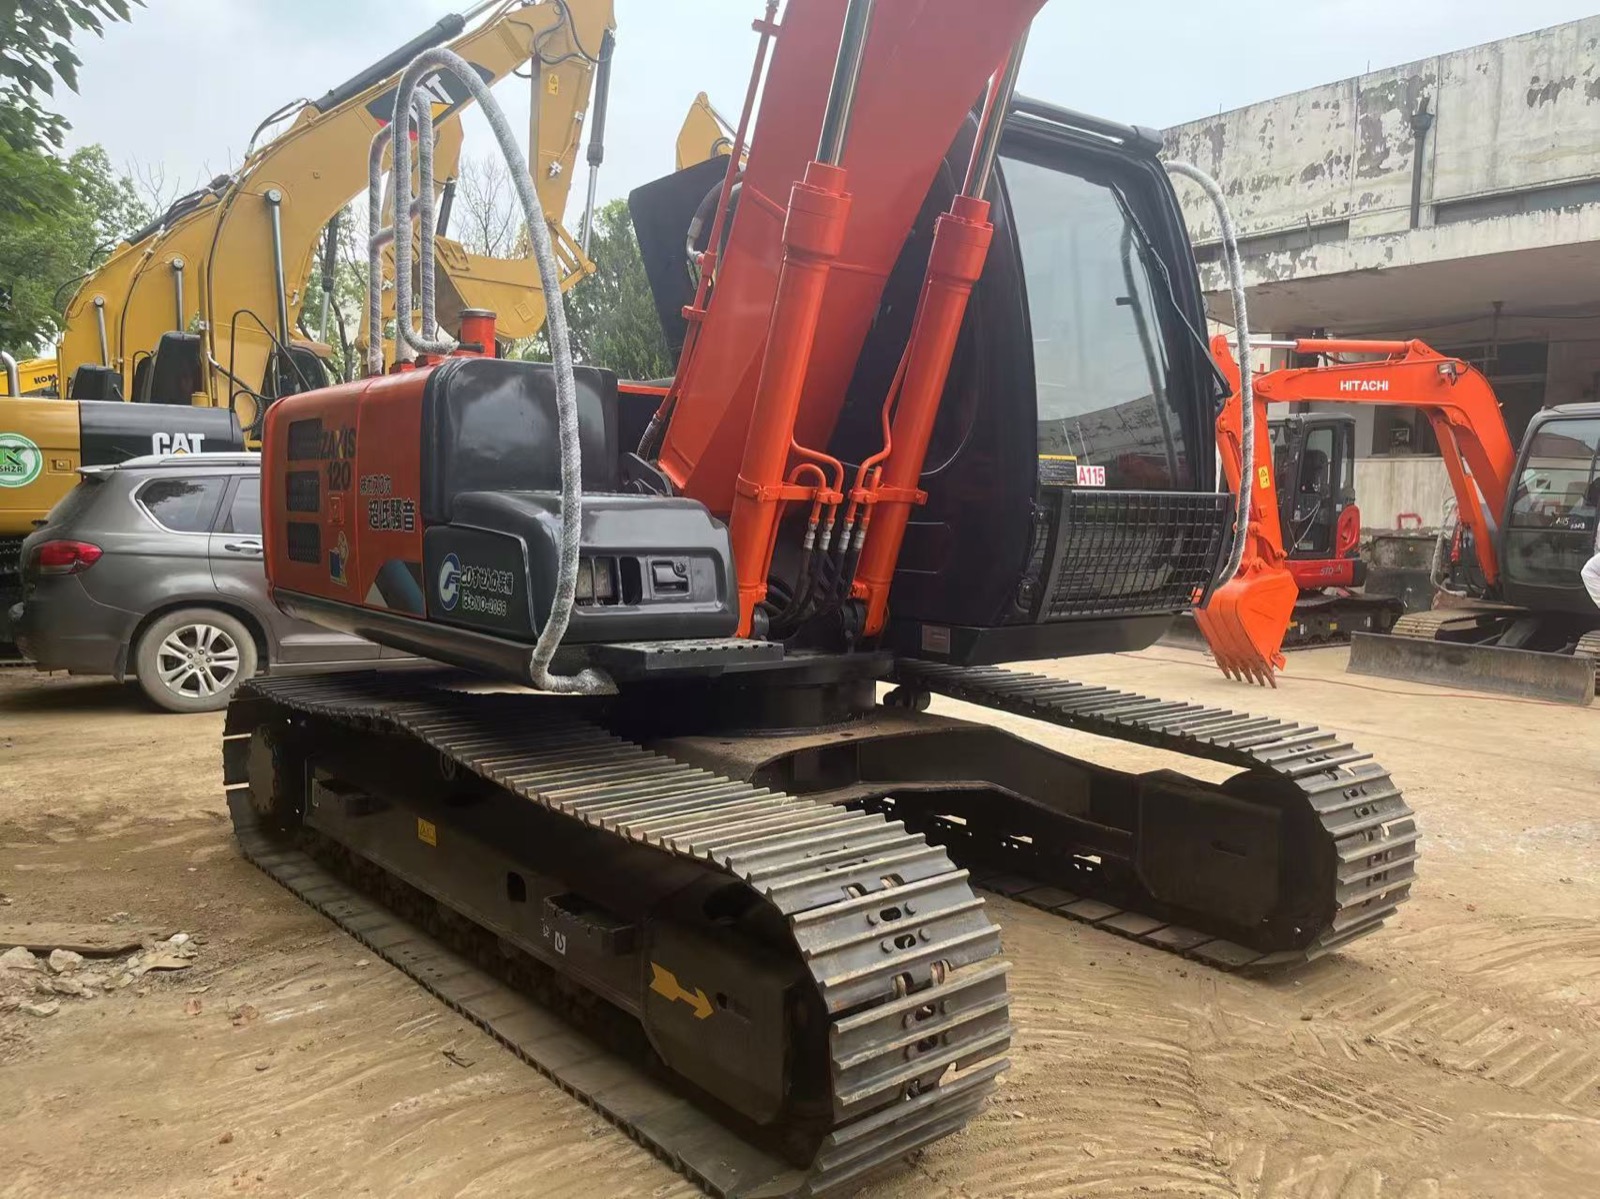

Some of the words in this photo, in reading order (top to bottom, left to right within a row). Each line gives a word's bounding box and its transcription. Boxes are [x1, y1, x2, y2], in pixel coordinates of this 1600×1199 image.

[1340, 380, 1389, 391] HITACHI
[152, 432, 205, 455] CAT
[327, 461, 352, 491] 120
[1078, 466, 1105, 485] A115
